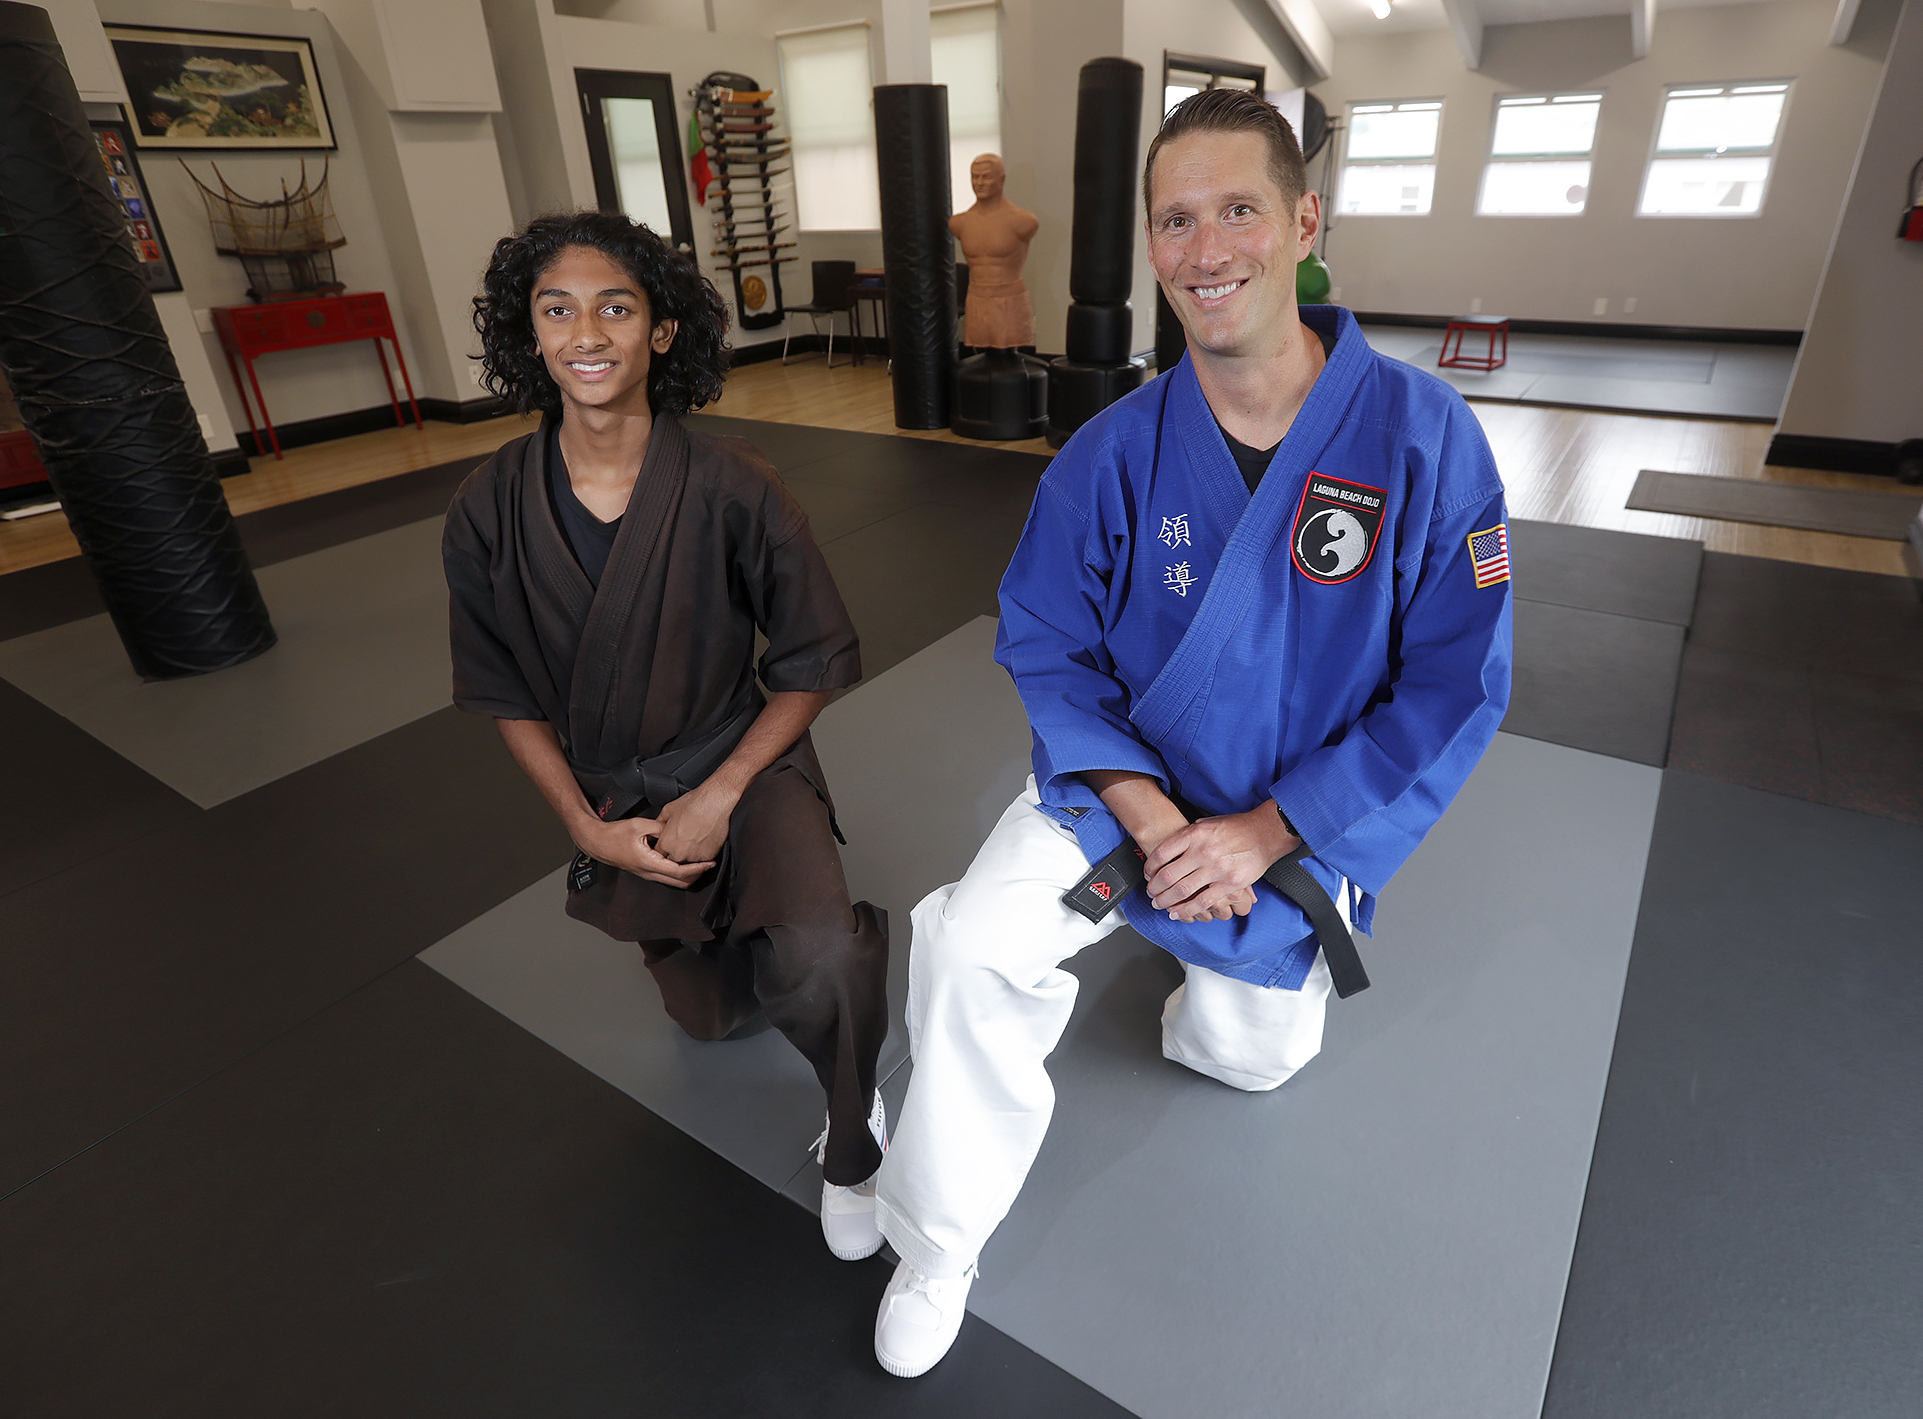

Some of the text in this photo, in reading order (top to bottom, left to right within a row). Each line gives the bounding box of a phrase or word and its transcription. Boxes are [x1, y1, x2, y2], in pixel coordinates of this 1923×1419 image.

[1312, 482, 1380, 508] LAGUNA BEACH DOJO
